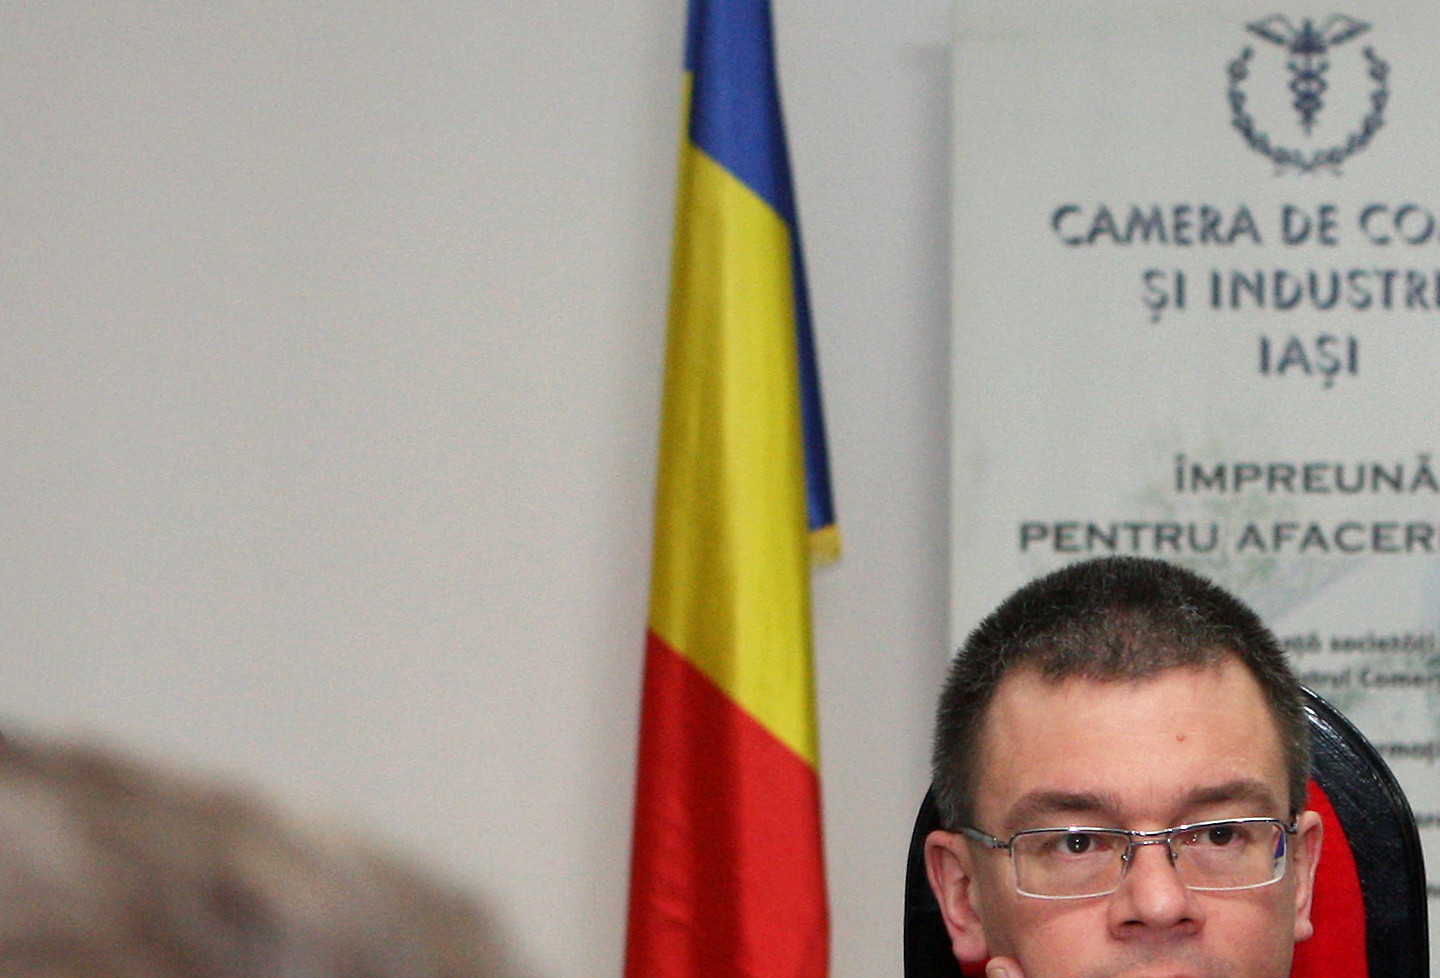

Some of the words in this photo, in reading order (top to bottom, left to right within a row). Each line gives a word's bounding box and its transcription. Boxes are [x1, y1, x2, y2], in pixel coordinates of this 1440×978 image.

[1051, 204, 1262, 247] CAMERA
[1281, 204, 1338, 247] DE
[1175, 454, 1440, 494] ÎMPREUNĂ
[1019, 521, 1219, 553] PENTRU
